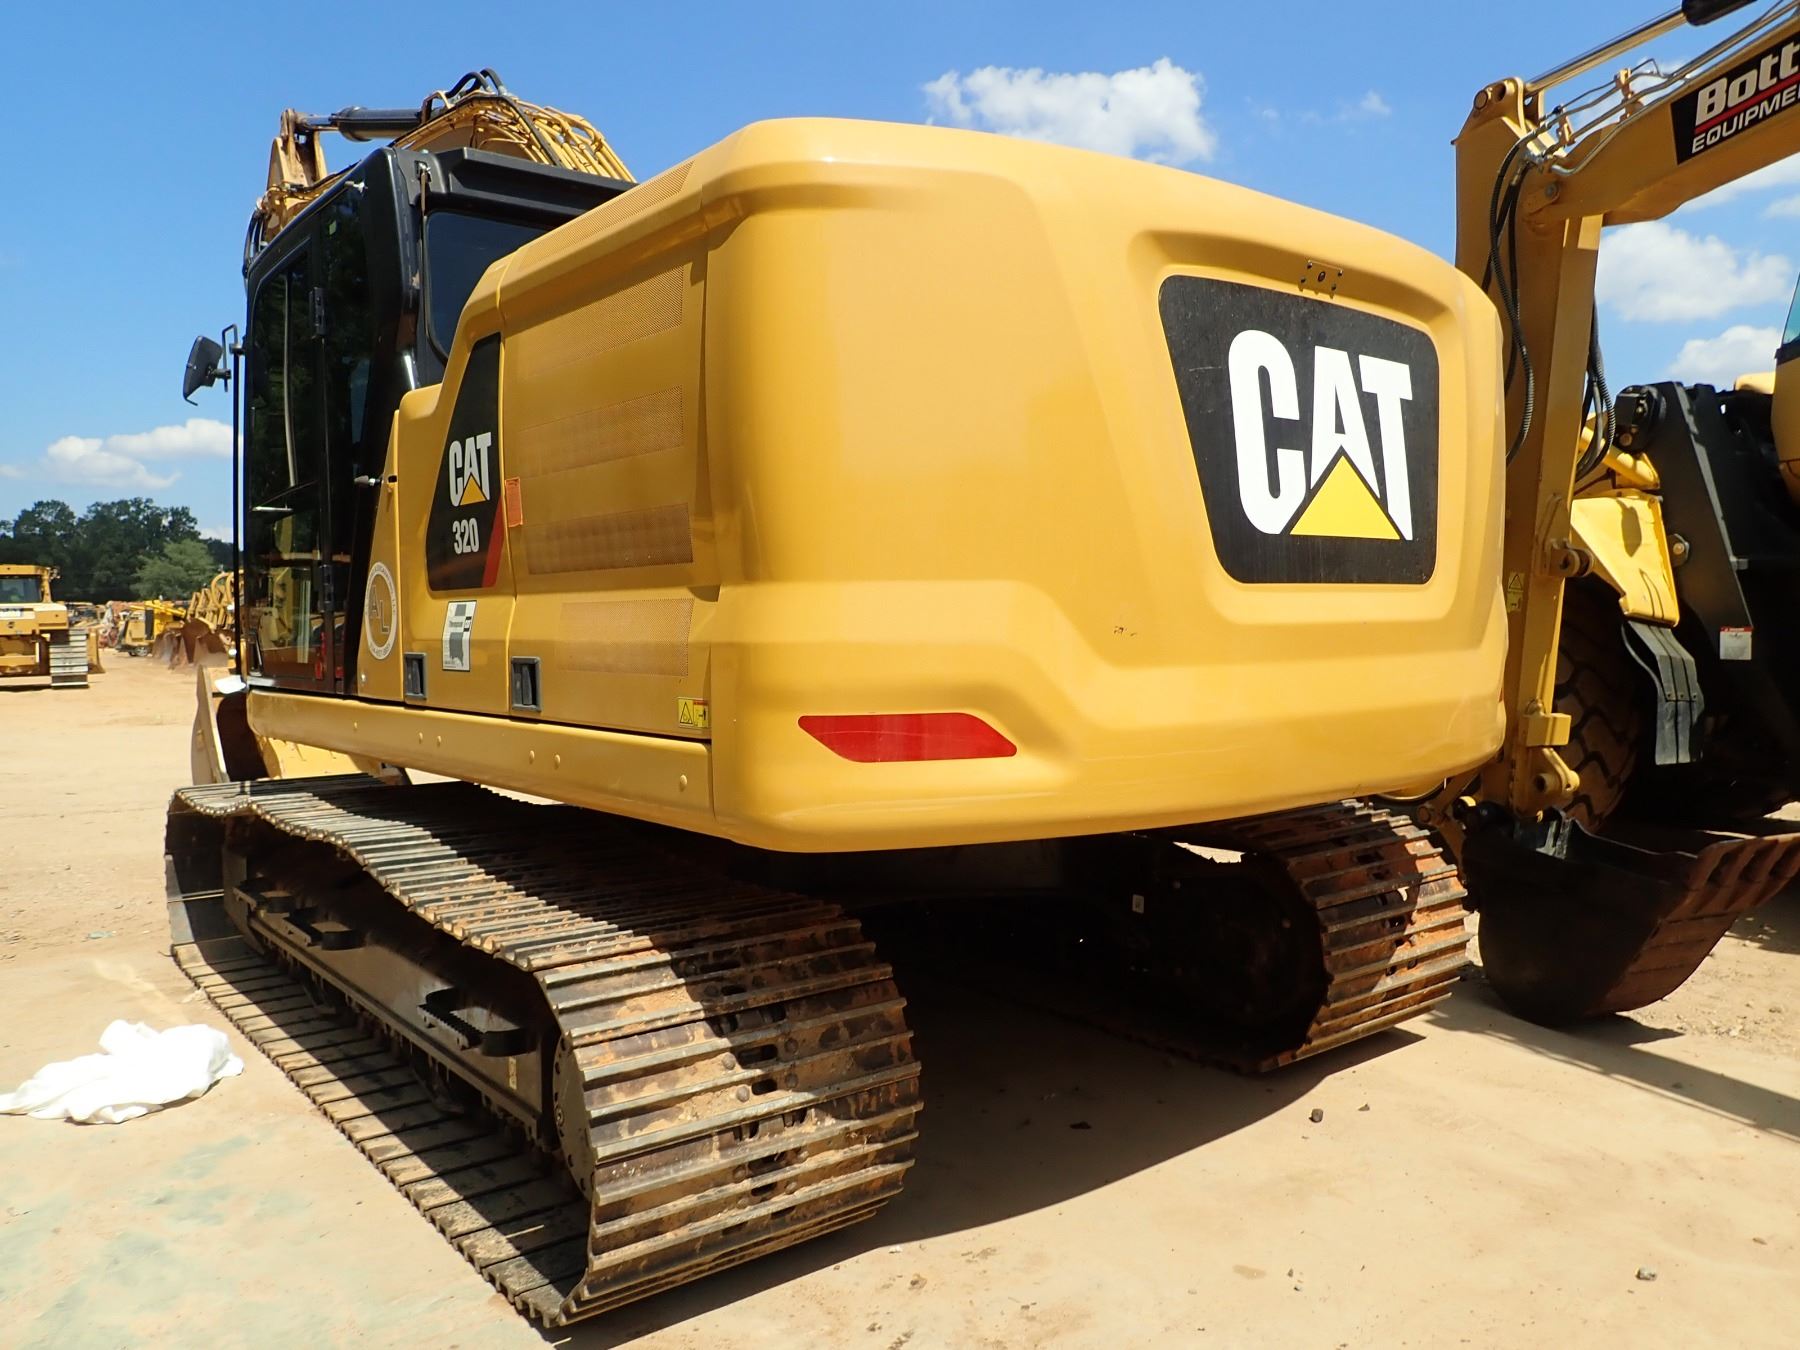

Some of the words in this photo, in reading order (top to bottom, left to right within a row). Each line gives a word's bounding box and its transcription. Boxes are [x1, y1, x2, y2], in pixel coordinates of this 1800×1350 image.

[1692, 83, 1800, 153] EQUIPME
[449, 432, 492, 507] CAT
[1228, 329, 1413, 541] CAT
[452, 518, 480, 554] 320
